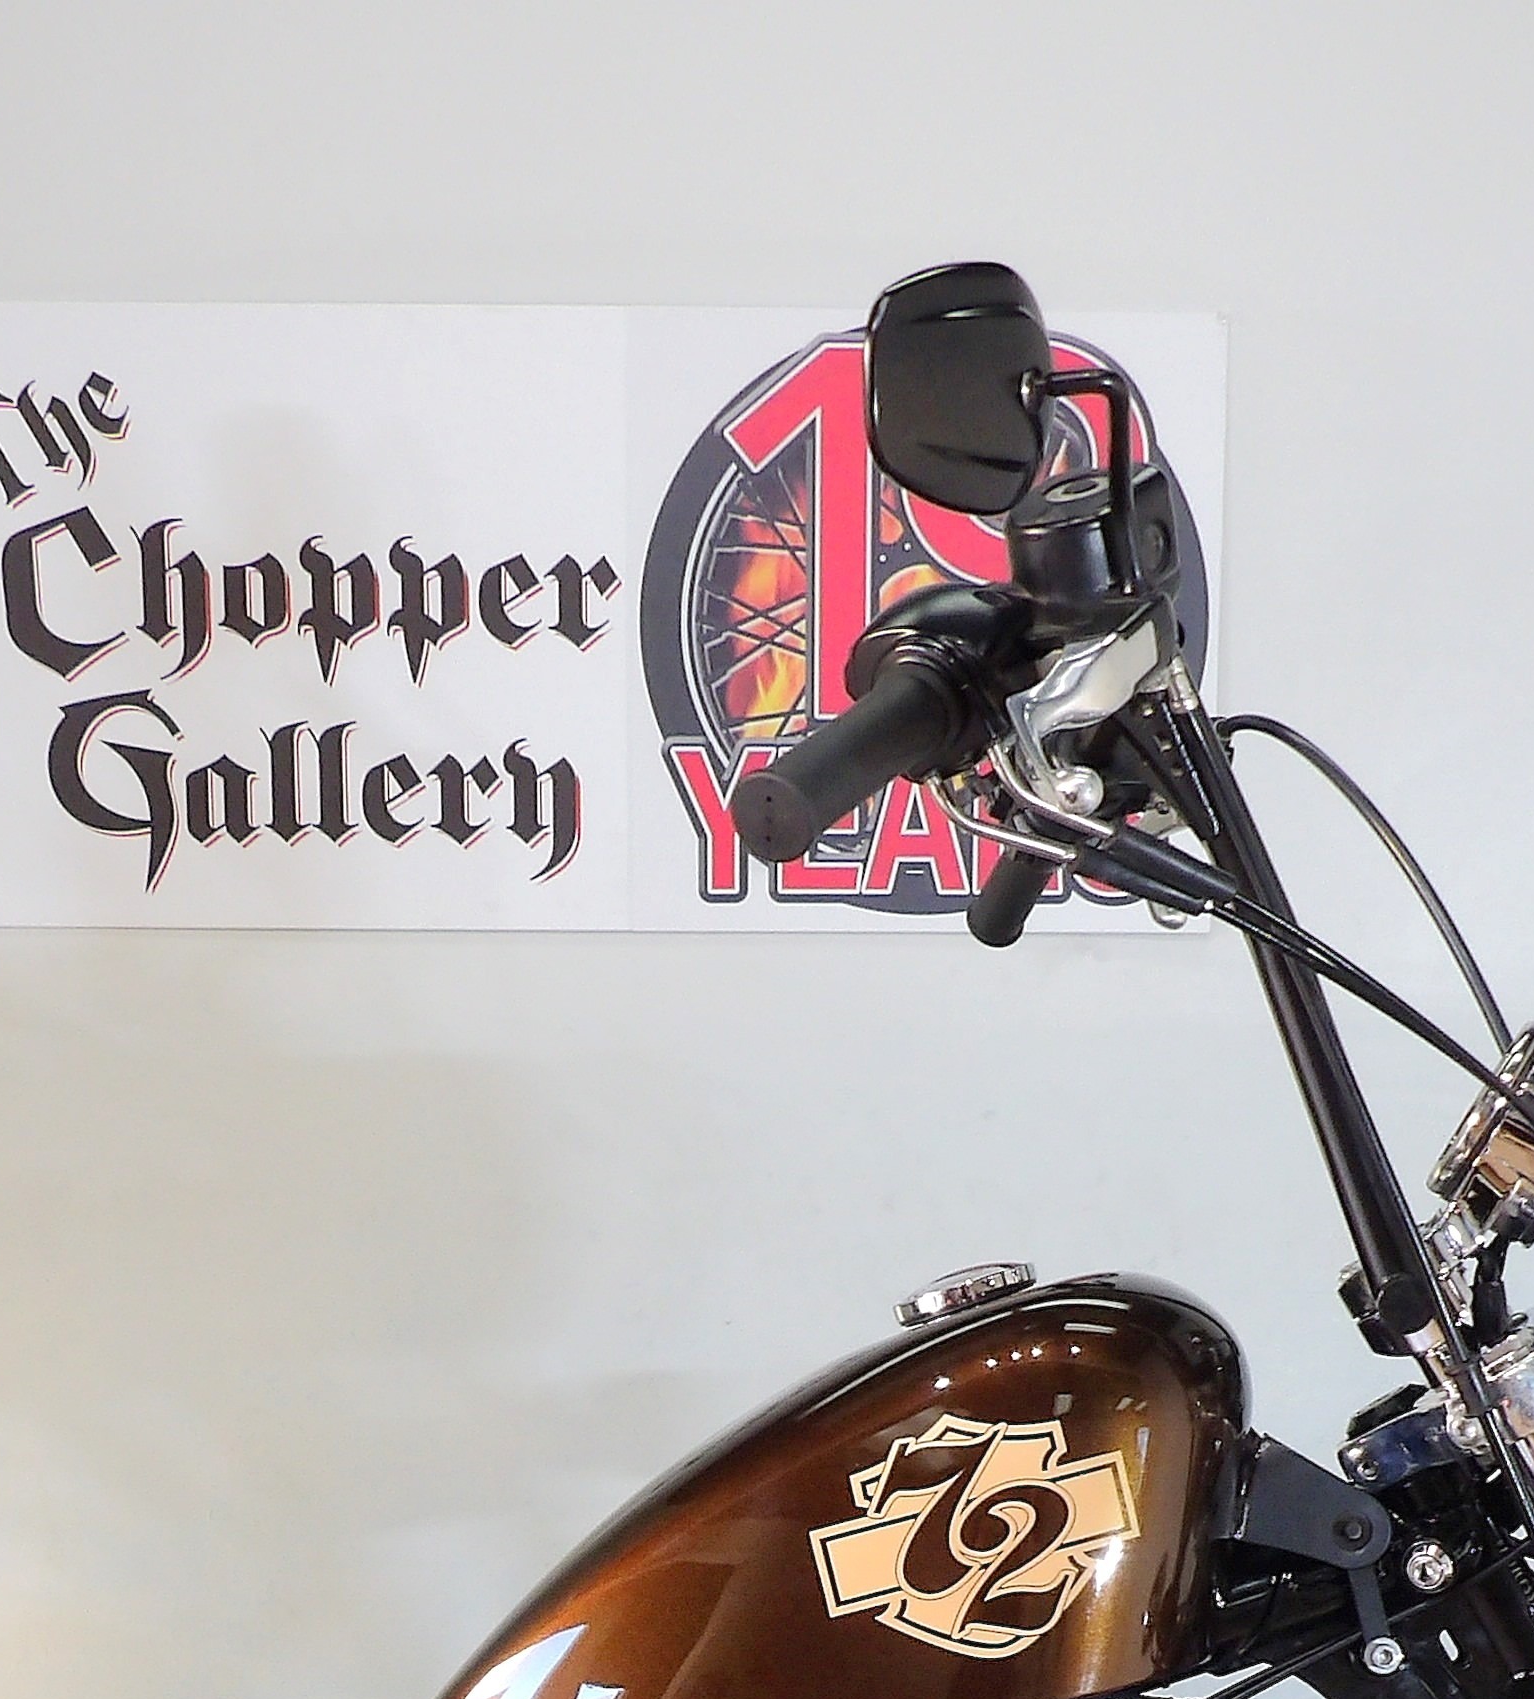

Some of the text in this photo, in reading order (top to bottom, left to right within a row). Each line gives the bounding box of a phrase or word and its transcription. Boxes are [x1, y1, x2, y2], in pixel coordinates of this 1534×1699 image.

[0, 505, 623, 688] Chopper
[47, 688, 583, 894] Gallery
[867, 1421, 1079, 1640] 72
